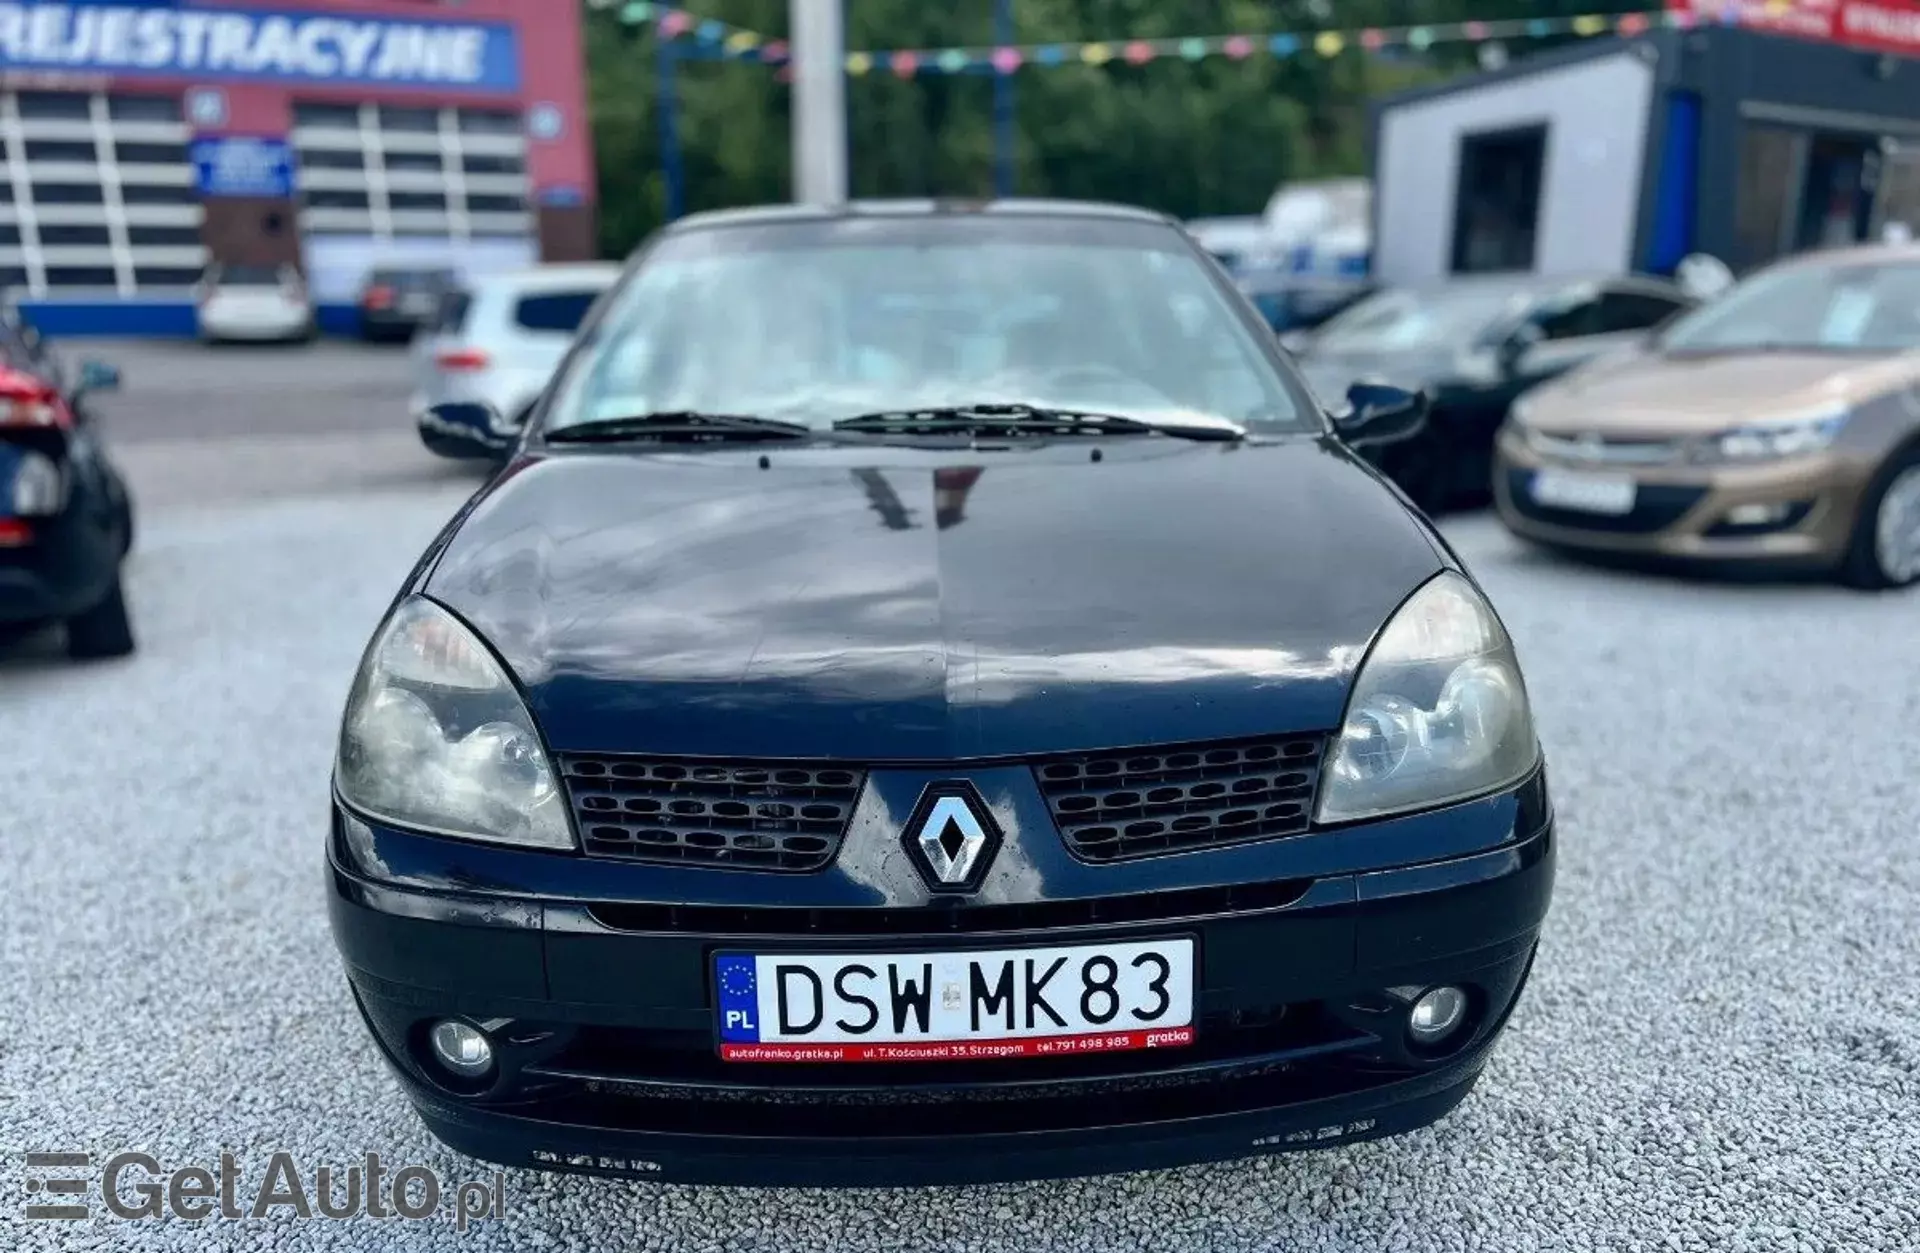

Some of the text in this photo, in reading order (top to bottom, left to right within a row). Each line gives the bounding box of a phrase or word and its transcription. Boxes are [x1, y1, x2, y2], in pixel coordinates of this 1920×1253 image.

[776, 952, 1171, 1035] DSW MK83
[726, 1010, 754, 1029] PL
[729, 1049, 844, 1061] autofranko.gratka.pl
[1079, 1037, 1103, 1050] 498
[1107, 1036, 1129, 1047] 985
[1147, 1031, 1189, 1048] gratka
